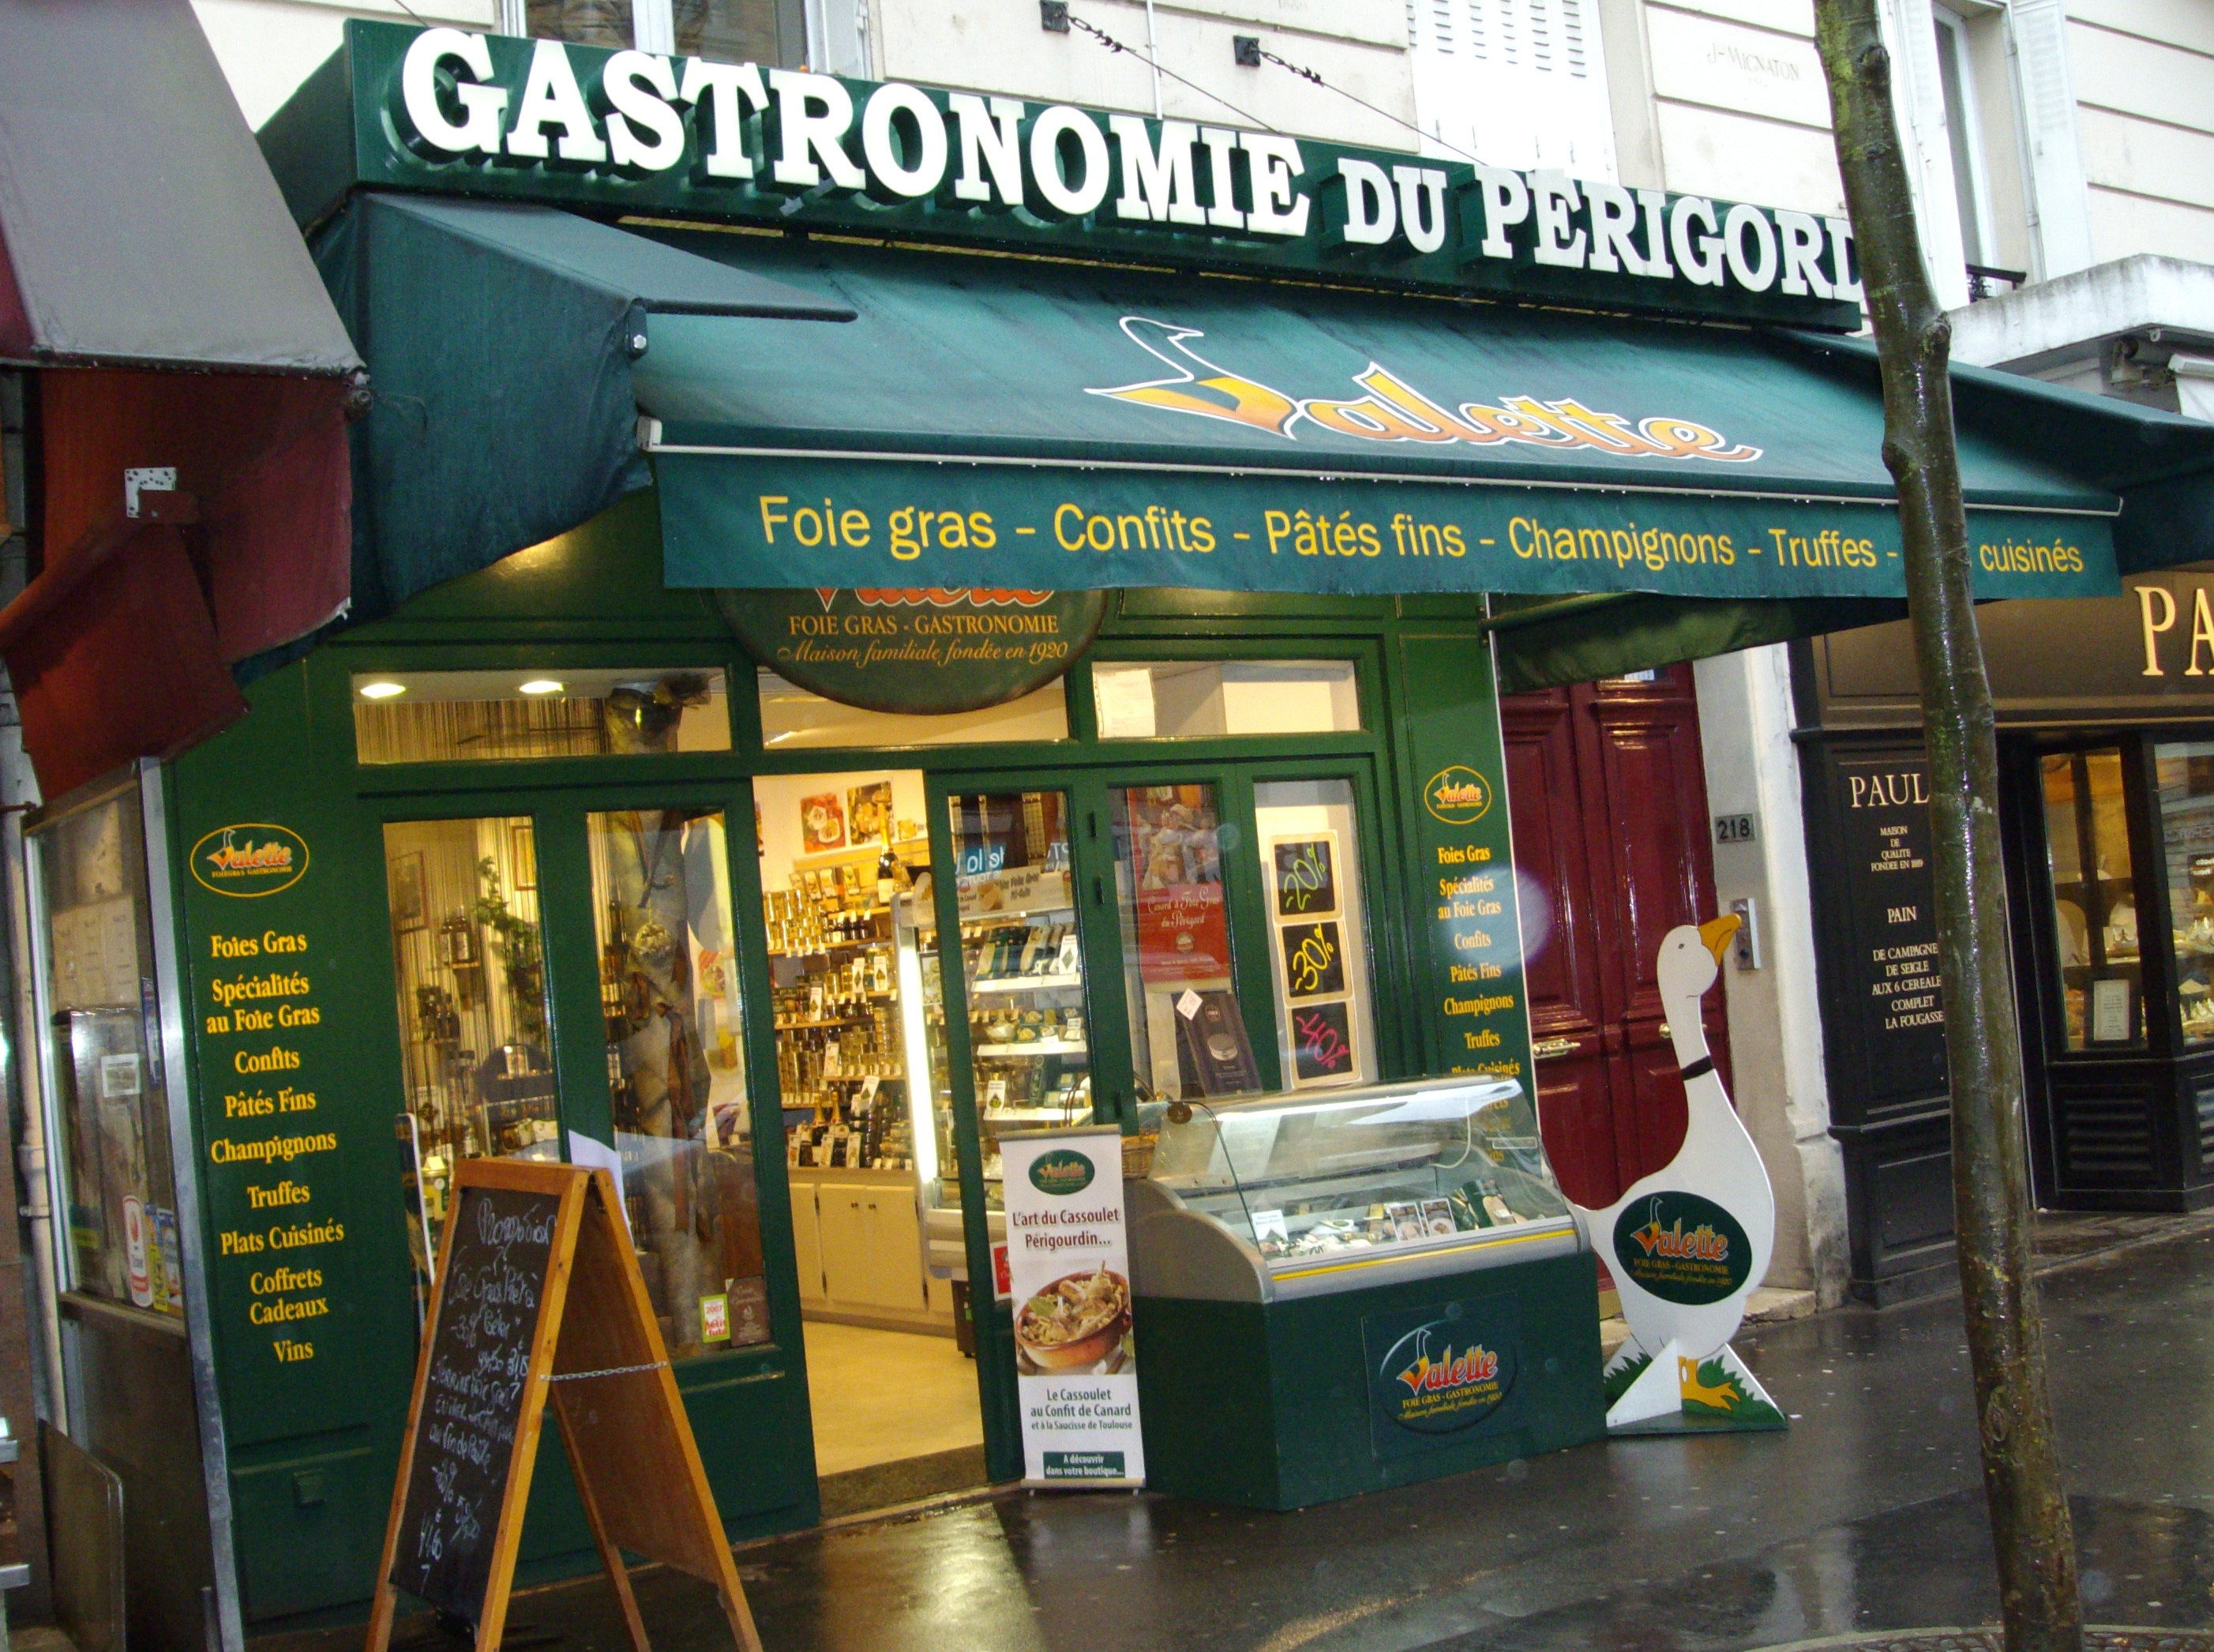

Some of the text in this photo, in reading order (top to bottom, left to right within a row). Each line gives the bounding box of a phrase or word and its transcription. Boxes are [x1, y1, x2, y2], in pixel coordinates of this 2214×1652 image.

[403, 28, 1312, 237] GASTRONOMIE
[1338, 158, 1448, 253] DU
[1083, 316, 1764, 463] Valette
[760, 496, 870, 547] Foie
[889, 507, 996, 560] gras
[1054, 503, 1216, 553] Confits
[1265, 509, 1381, 557] Pâtés
[1390, 513, 1465, 557] fins
[1508, 516, 1736, 570] Champignons
[1768, 528, 1878, 568] Truffes
[1979, 539, 2085, 573] cuisinés
[790, 615, 839, 636] FOIE
[844, 615, 898, 636] GRAS
[914, 614, 1059, 634] GASTRONOMIE
[777, 638, 1068, 668] Maison familiale fondée en 1920
[1849, 773, 1930, 808] PAUL
[1717, 818, 1751, 840] 218
[1880, 826, 1908, 835] MAISON
[207, 828, 292, 870] Valette
[1438, 844, 1491, 864] Foies Gras
[1890, 839, 1900, 847] DE
[1285, 843, 1327, 910] -20%
[1439, 875, 1494, 899] Spécialités
[1438, 899, 1501, 919] au Foie Gras
[1887, 906, 1917, 923] PAIN
[210, 930, 307, 958] Foies Gras
[1454, 929, 1492, 949] Confits
[1293, 923, 1334, 990] -30%
[1873, 943, 1938, 961] DE CAMPAGNE
[1450, 962, 1502, 982] Pâtés Fins
[1886, 960, 1929, 977] DE SEIGLE
[212, 971, 310, 1007] Spécialités
[1872, 982, 1893, 995] AUX
[1894, 982, 1900, 992] 6
[1444, 993, 1514, 1016] Champignons
[1891, 995, 1934, 1011] COMPLET
[206, 1004, 321, 1034] au Foie Gras
[1885, 1010, 1944, 1030] LA FOUGASSE
[1297, 1012, 1349, 1069] -40%
[1464, 1029, 1500, 1049] Truffes
[235, 1046, 300, 1073] Confits
[224, 1087, 317, 1118] Pâtés Fins
[211, 1132, 337, 1164] Champignons
[247, 1181, 310, 1208] Truffes
[1012, 1207, 1119, 1226] L'art du Cassoulet
[1630, 1196, 1729, 1261] Valette
[220, 1218, 344, 1256] Plats Cuisinés
[1025, 1230, 1111, 1251] Périgourdin...
[1675, 1260, 1730, 1275] GASTRONOMIE
[250, 1267, 323, 1295] Coffrets
[250, 1297, 329, 1325] Cadeaux
[273, 1339, 314, 1363] Vins
[1396, 1328, 1499, 1396] Valette
[1046, 1387, 1112, 1401] Le Cassoulet
[1402, 1382, 1499, 1409] FOIE GRAS GASTRONOMIE
[1030, 1403, 1131, 1417] au Confit de Canard
[1046, 1421, 1053, 1429] la
[1054, 1421, 1086, 1430] Saucisse
[1087, 1421, 1098, 1429] de
[1098, 1420, 1133, 1429] Toulouse
